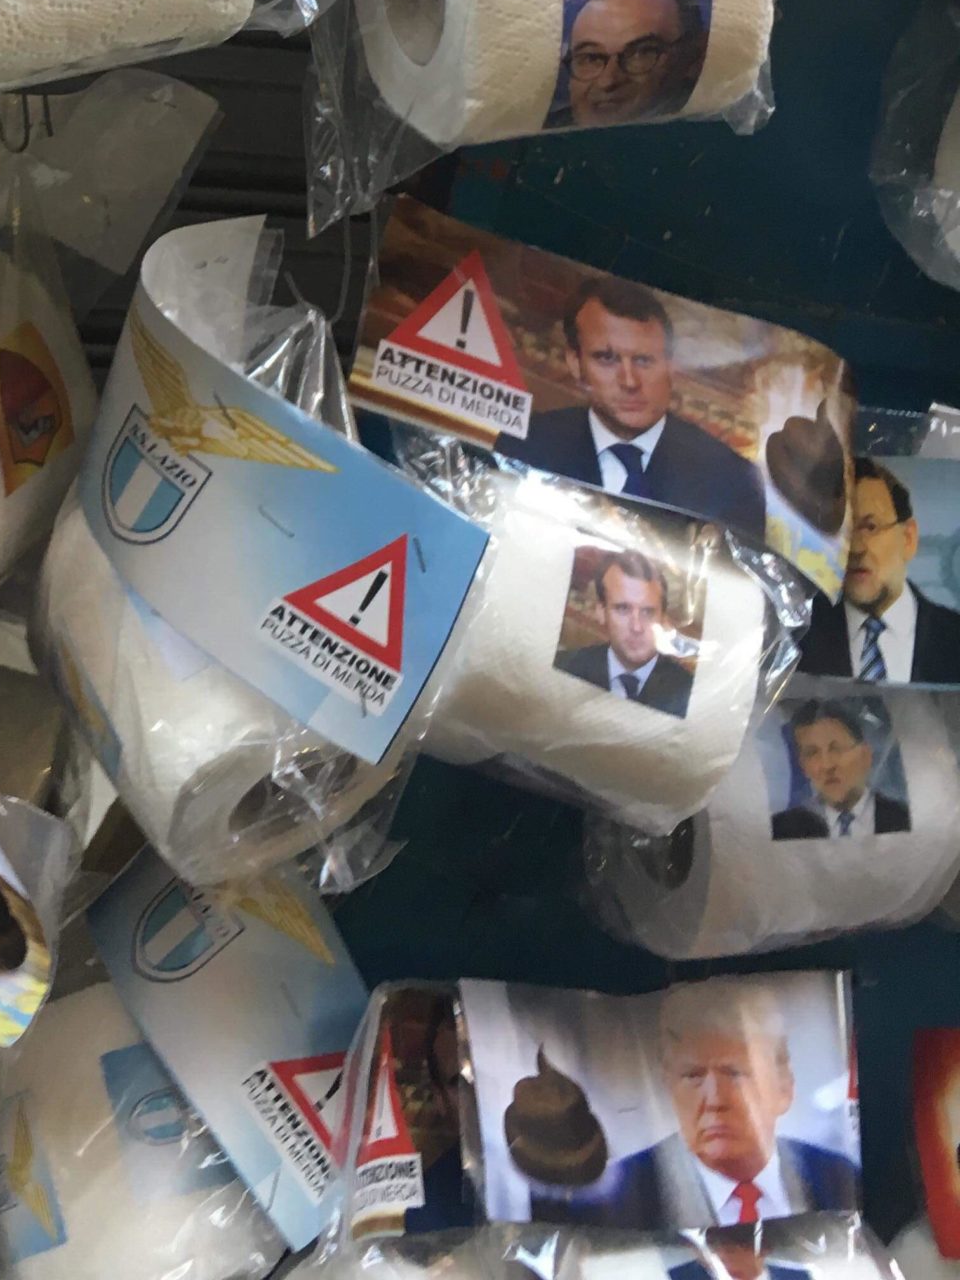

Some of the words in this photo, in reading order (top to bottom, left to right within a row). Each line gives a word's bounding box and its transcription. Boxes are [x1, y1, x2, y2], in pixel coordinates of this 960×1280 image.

[375, 365, 434, 399] PUZZA
[437, 387, 456, 406] DI
[461, 396, 524, 431] MERDA
[380, 346, 527, 413] ATTENZIONE
[260, 617, 312, 660] PUZZA
[311, 652, 332, 673] DI
[331, 664, 386, 708] MERDA
[269, 603, 399, 692] ATTENZIONE
[241, 1077, 279, 1128] PUZZA
[287, 1142, 326, 1199] MERDA
